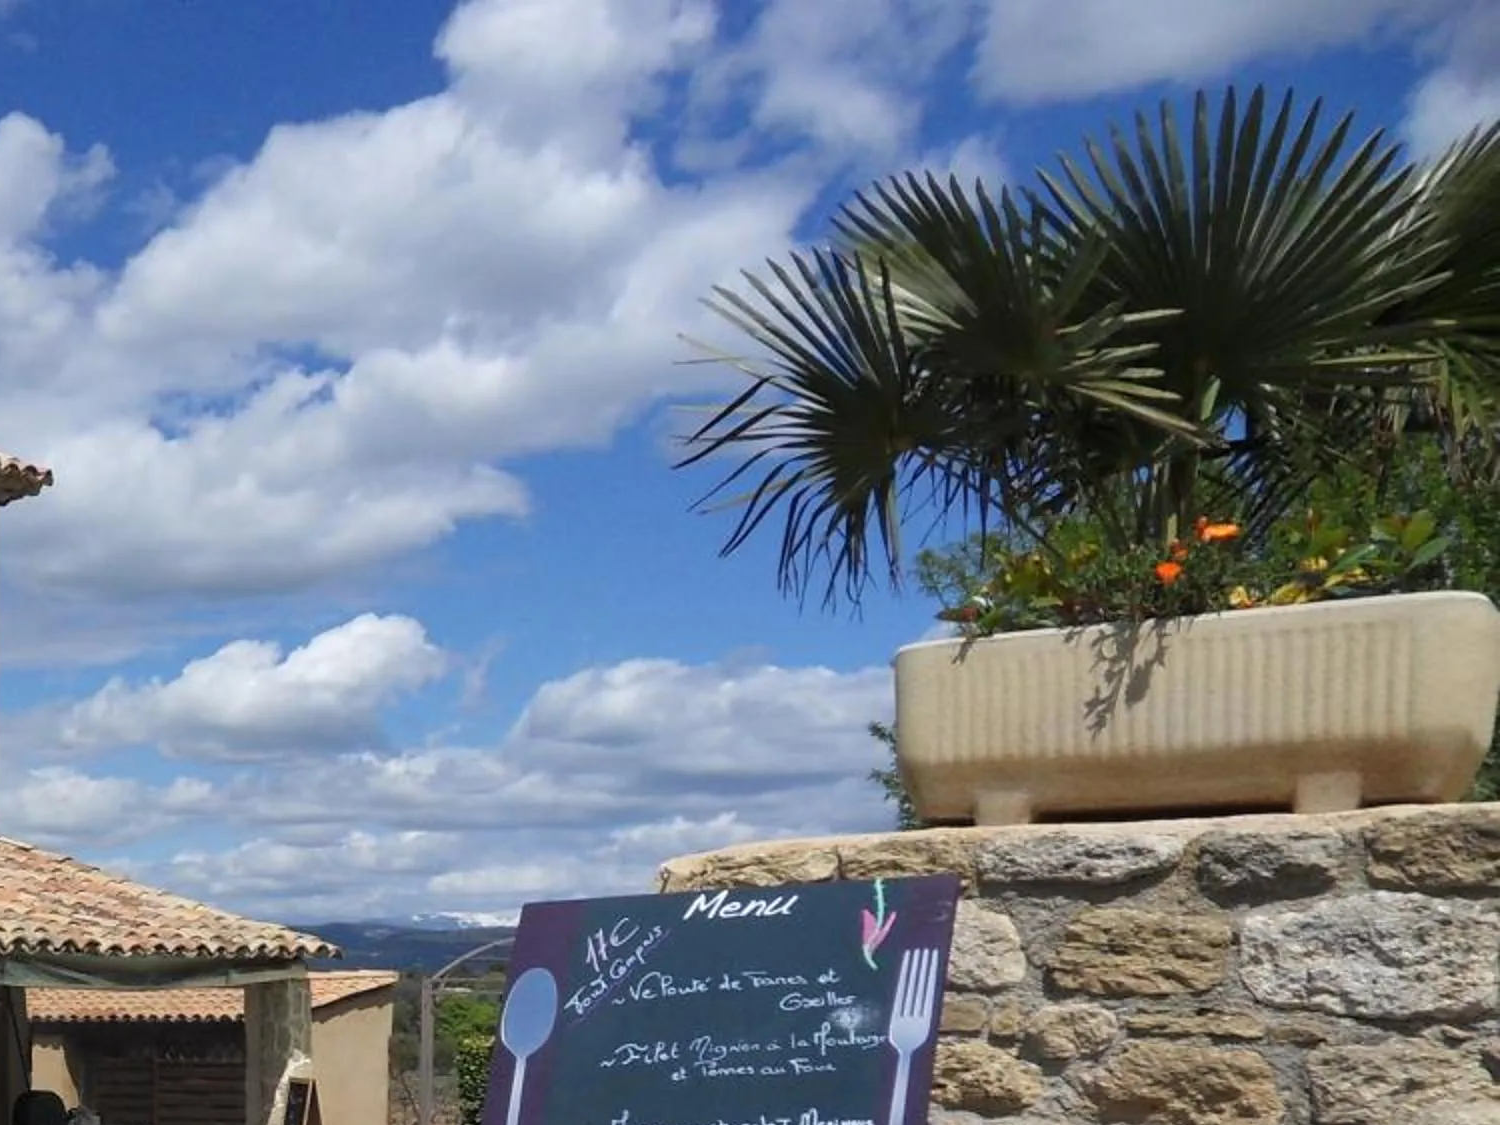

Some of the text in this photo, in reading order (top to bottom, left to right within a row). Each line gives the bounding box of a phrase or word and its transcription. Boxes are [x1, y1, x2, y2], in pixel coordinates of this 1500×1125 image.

[682, 889, 799, 921] Menu
[718, 974, 744, 991] de
[816, 967, 841, 984] et
[790, 1032, 811, 1049] la
[671, 1067, 689, 1082] et
